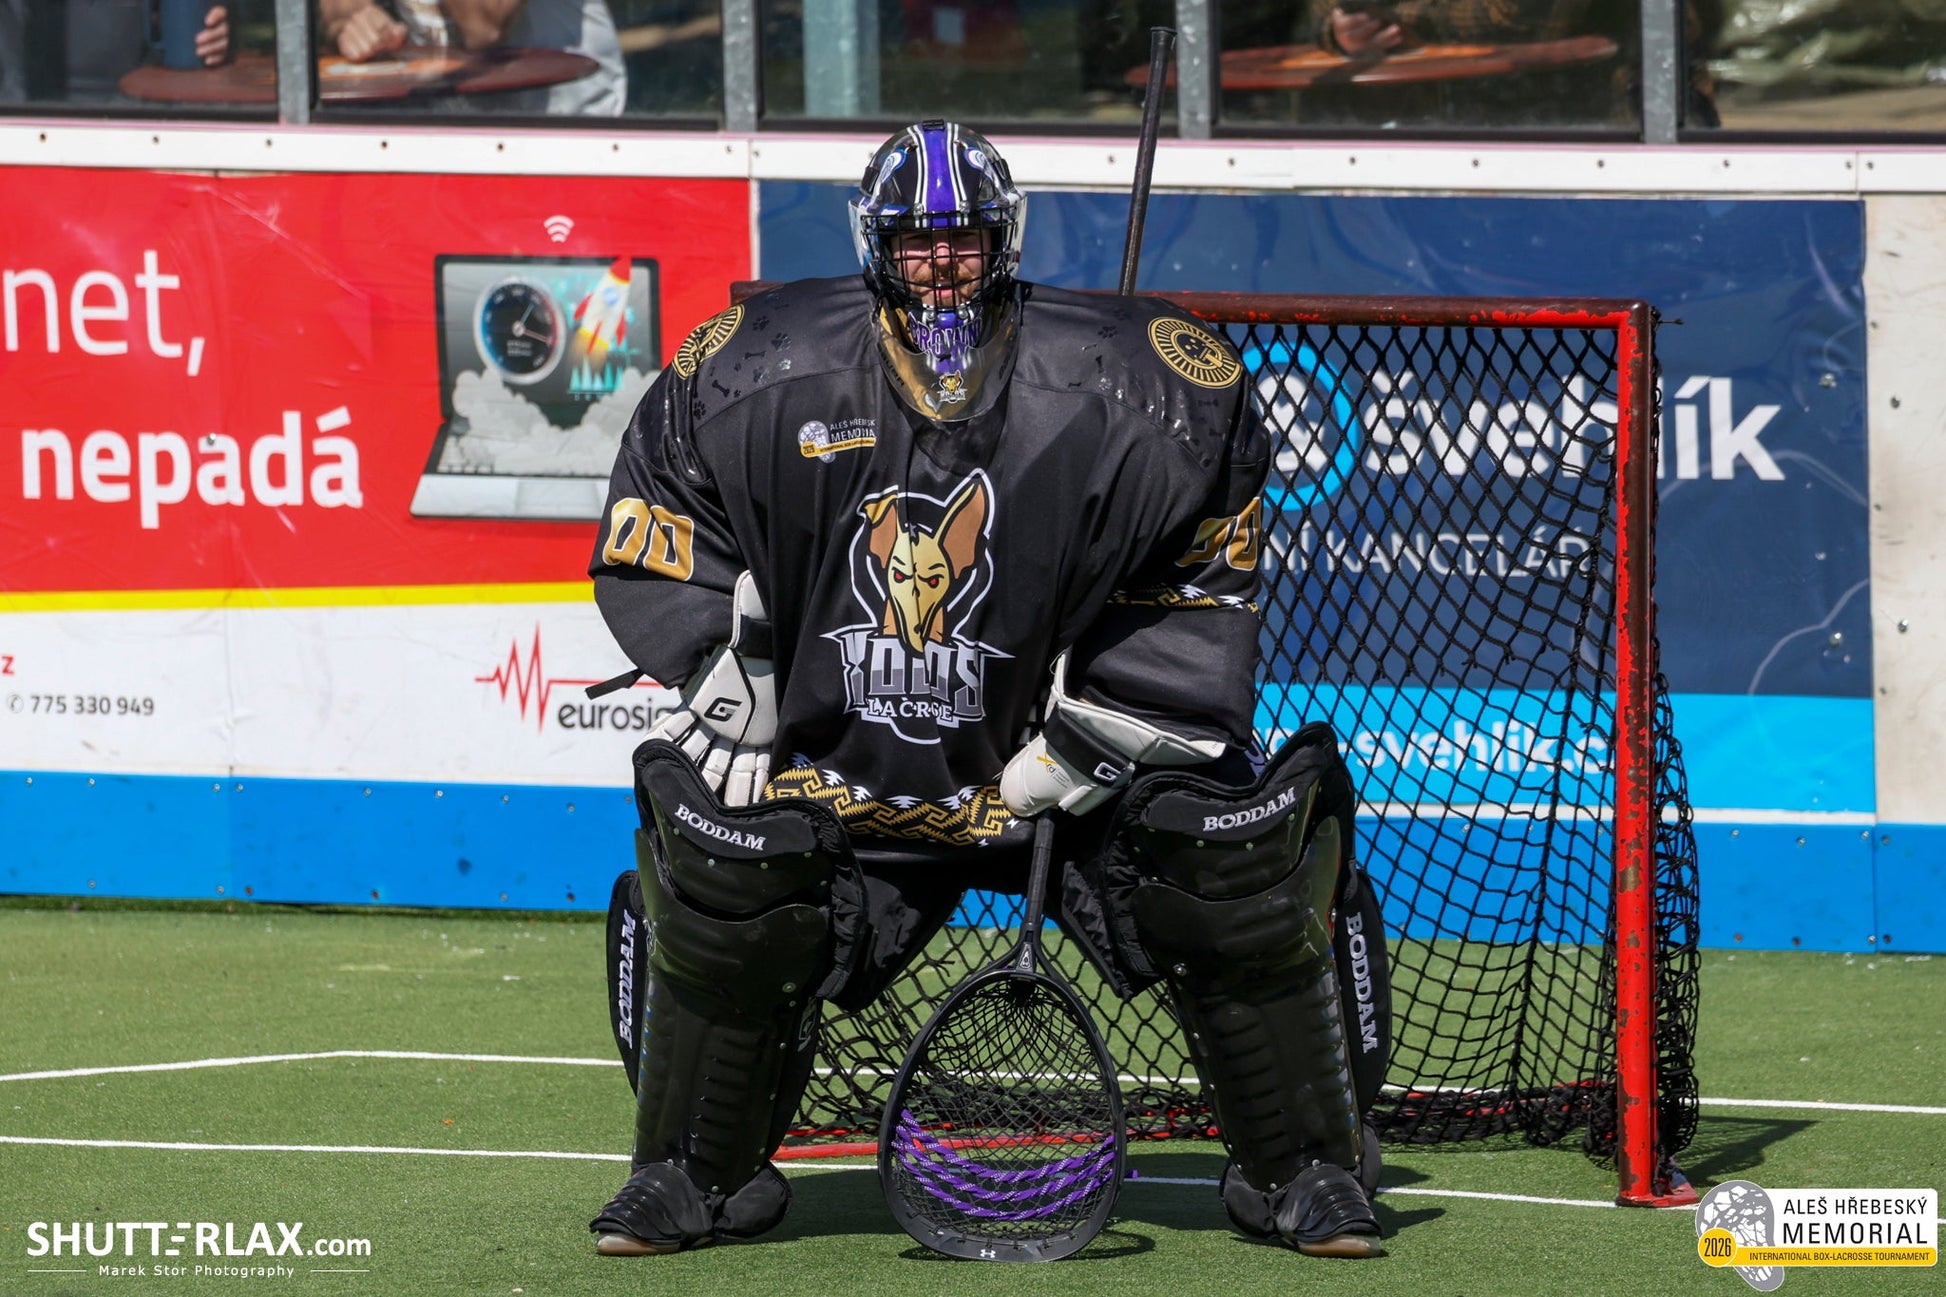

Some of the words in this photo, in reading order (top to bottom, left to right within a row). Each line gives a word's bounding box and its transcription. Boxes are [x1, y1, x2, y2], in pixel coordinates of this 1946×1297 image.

[3, 250, 205, 376] net,
[21, 405, 363, 529] nepadá
[1365, 370, 1785, 481] švehík
[602, 497, 694, 581] 00
[31, 695, 67, 714] 775
[73, 695, 111, 715] 330
[117, 697, 155, 716] 949
[558, 698, 674, 730] eurosi
[674, 803, 767, 851] BODDAM
[1202, 786, 1296, 832] BODDAM
[619, 908, 636, 1050] BODDAM
[1346, 911, 1378, 1054] BODDAM
